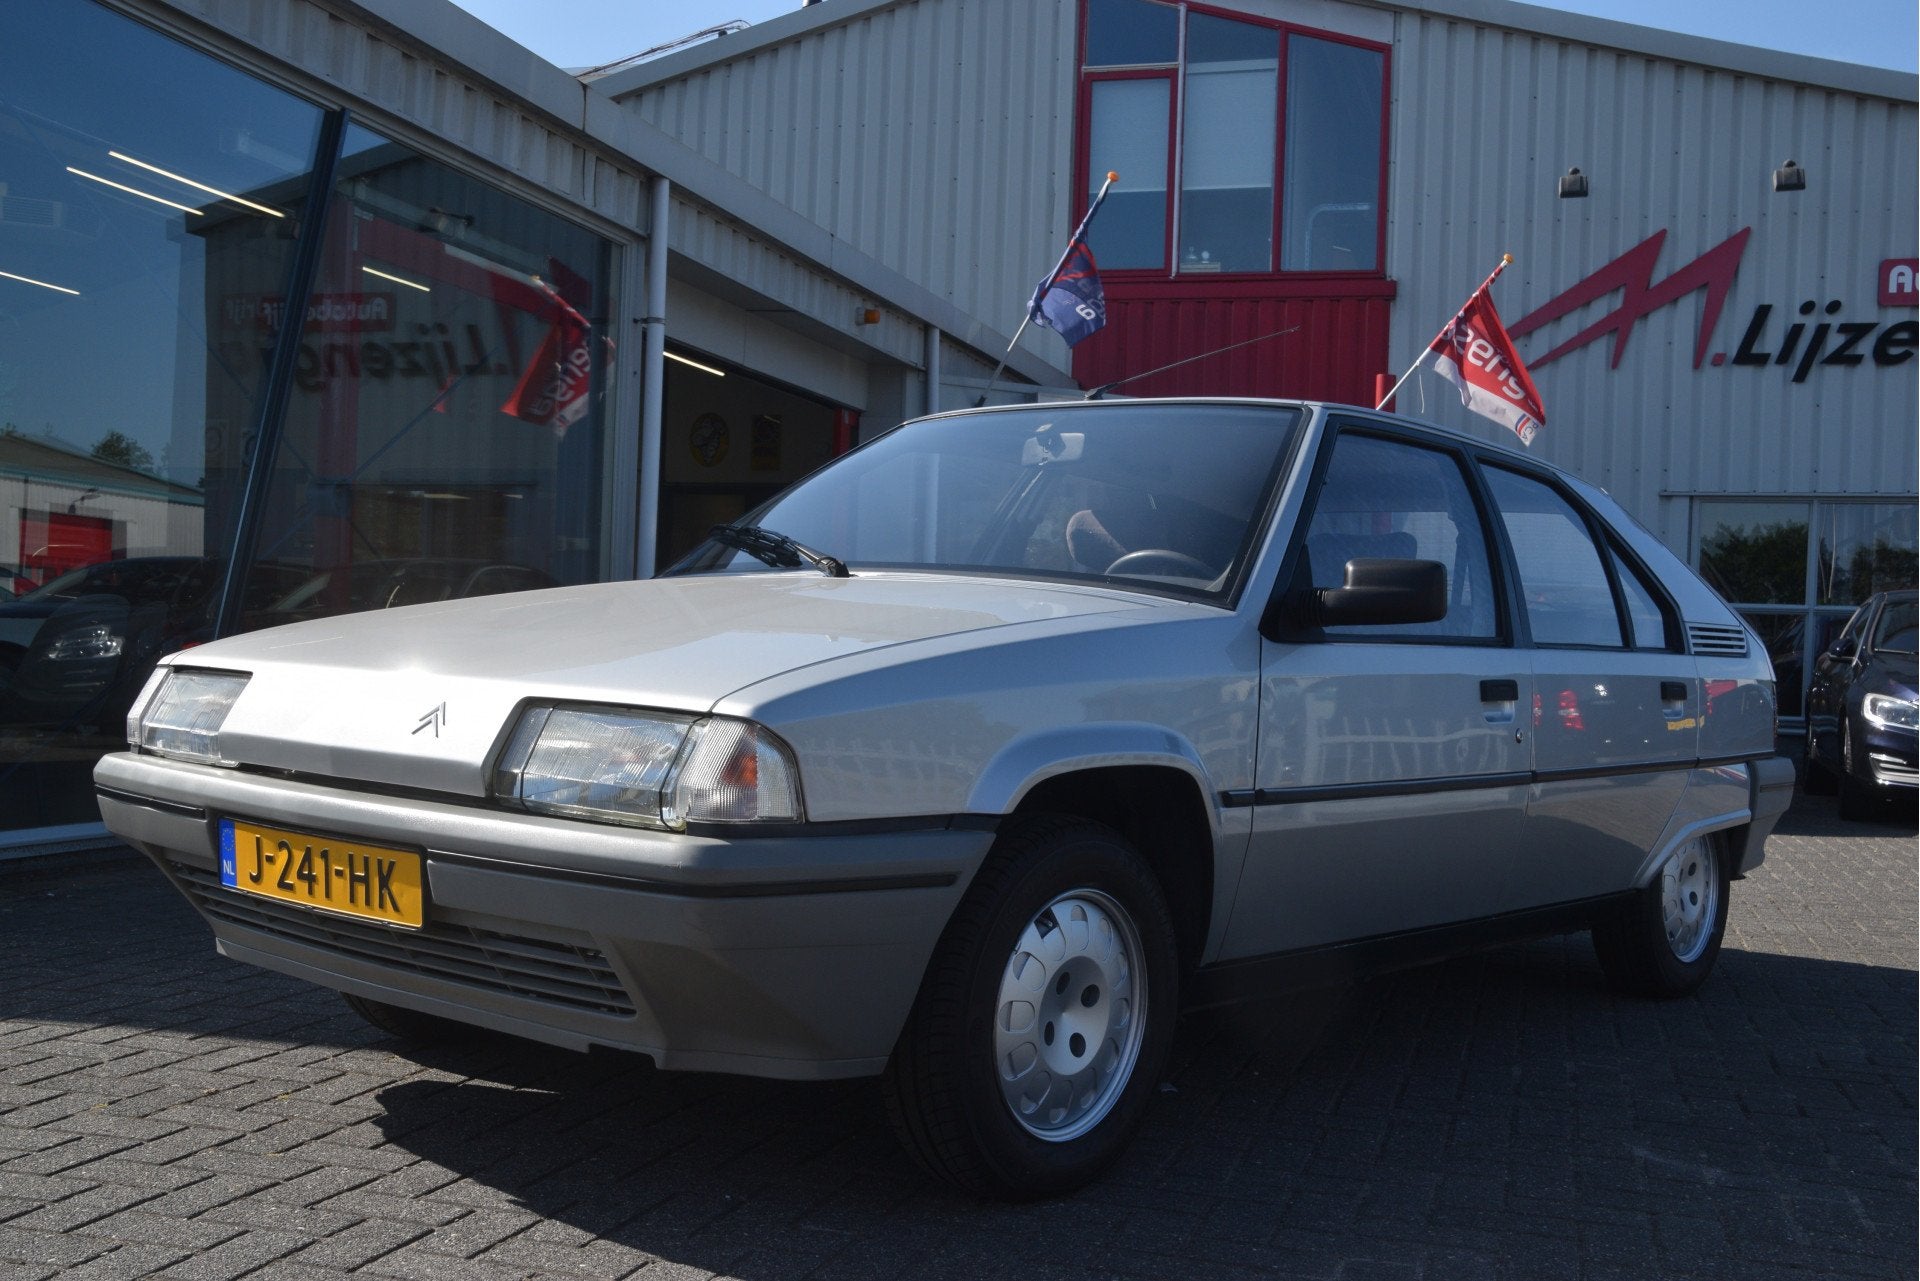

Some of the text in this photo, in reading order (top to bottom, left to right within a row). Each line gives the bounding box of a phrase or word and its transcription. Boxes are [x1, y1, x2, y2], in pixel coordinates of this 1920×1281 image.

[1888, 265, 1918, 293] A
[223, 860, 236, 876] NL
[249, 834, 401, 914] J-241-HK
